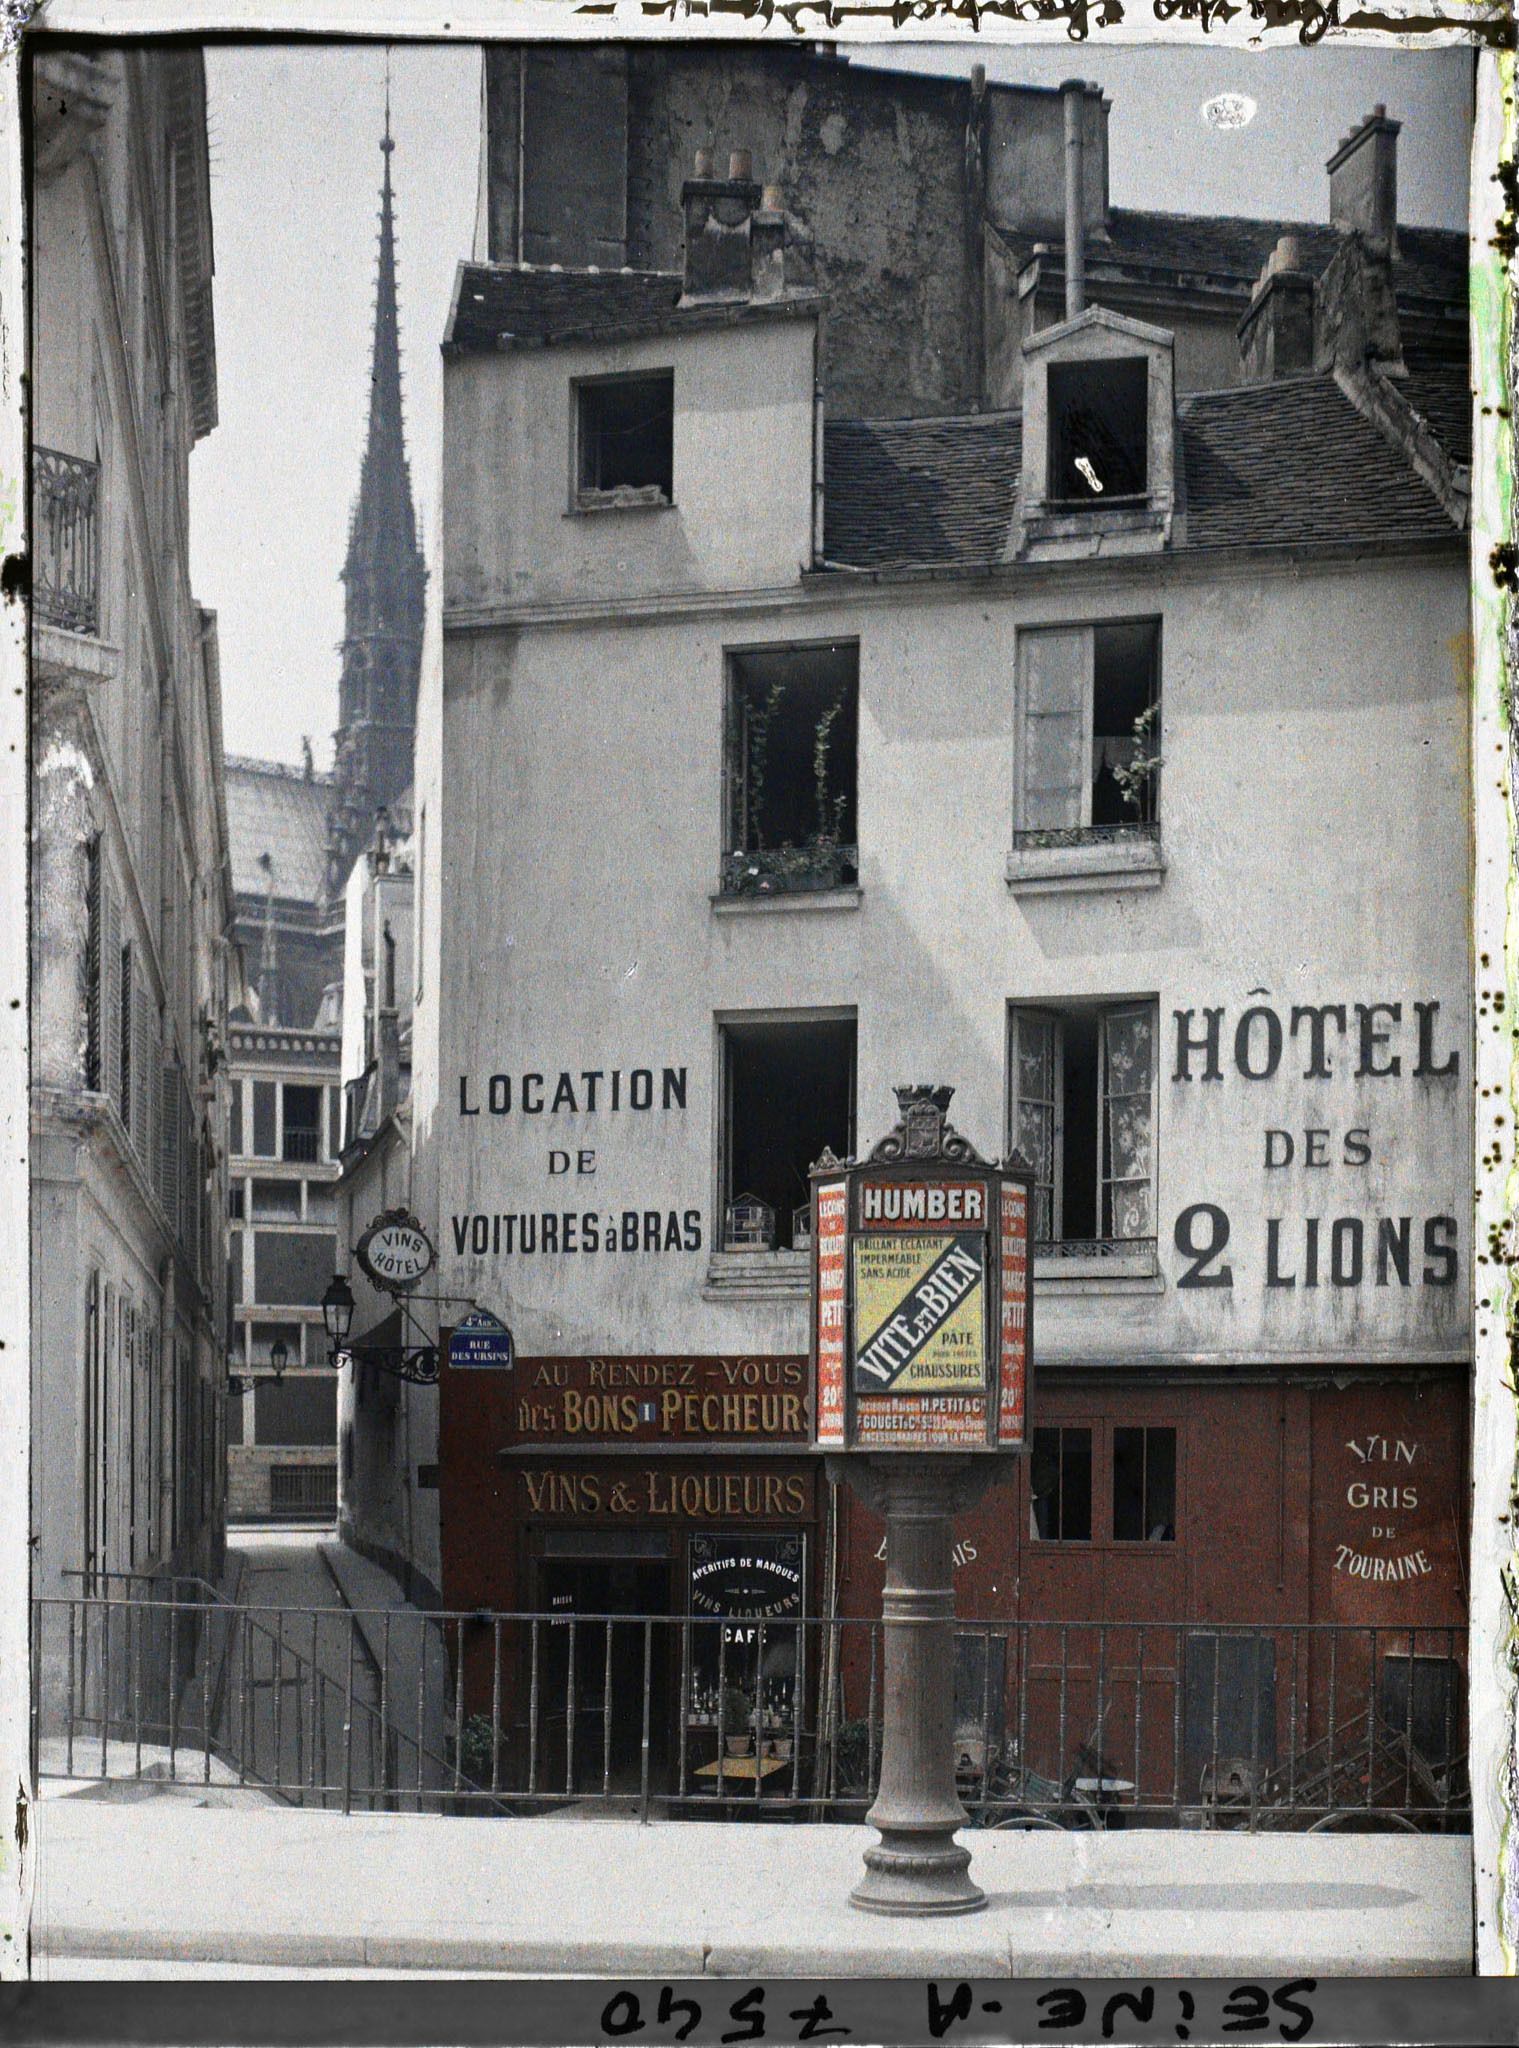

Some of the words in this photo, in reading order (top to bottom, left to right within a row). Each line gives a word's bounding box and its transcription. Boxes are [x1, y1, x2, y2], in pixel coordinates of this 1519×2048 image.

[1171, 987, 1460, 1082] HÔTEL
[459, 1067, 688, 1116] LOCATION
[548, 1150, 597, 1175] DE
[1262, 1128, 1373, 1168] DES
[864, 1188, 982, 1220] HUMBER
[382, 1232, 424, 1252] VINS
[452, 1212, 600, 1256] VOITURES
[605, 1214, 618, 1252] à
[621, 1210, 702, 1252] BRAS
[1174, 1203, 1234, 1289] 2
[1266, 1217, 1458, 1288] LIONS
[915, 1245, 982, 1318] BIEN
[913, 1307, 938, 1334] ET
[451, 1351, 470, 1361] DES
[473, 1351, 508, 1361] URSINS
[469, 1340, 490, 1350] RUE
[857, 1315, 925, 1382] VITE
[534, 1364, 569, 1386] AU
[910, 1363, 981, 1378] CHAUSSURES
[563, 1390, 639, 1433] BONS
[1346, 1435, 1418, 1464] VIN
[521, 1471, 600, 1514] VINS
[609, 1480, 638, 1513] &
[646, 1471, 806, 1517] LIQUEURS
[1347, 1483, 1418, 1509] GRIS
[1371, 1526, 1396, 1539] DE
[740, 1558, 752, 1568] DE
[756, 1558, 800, 1583] MARQUES
[1333, 1544, 1432, 1581] TOURAINE
[692, 1589, 721, 1613] VINS
[600, 1985, 850, 2044] 7540
